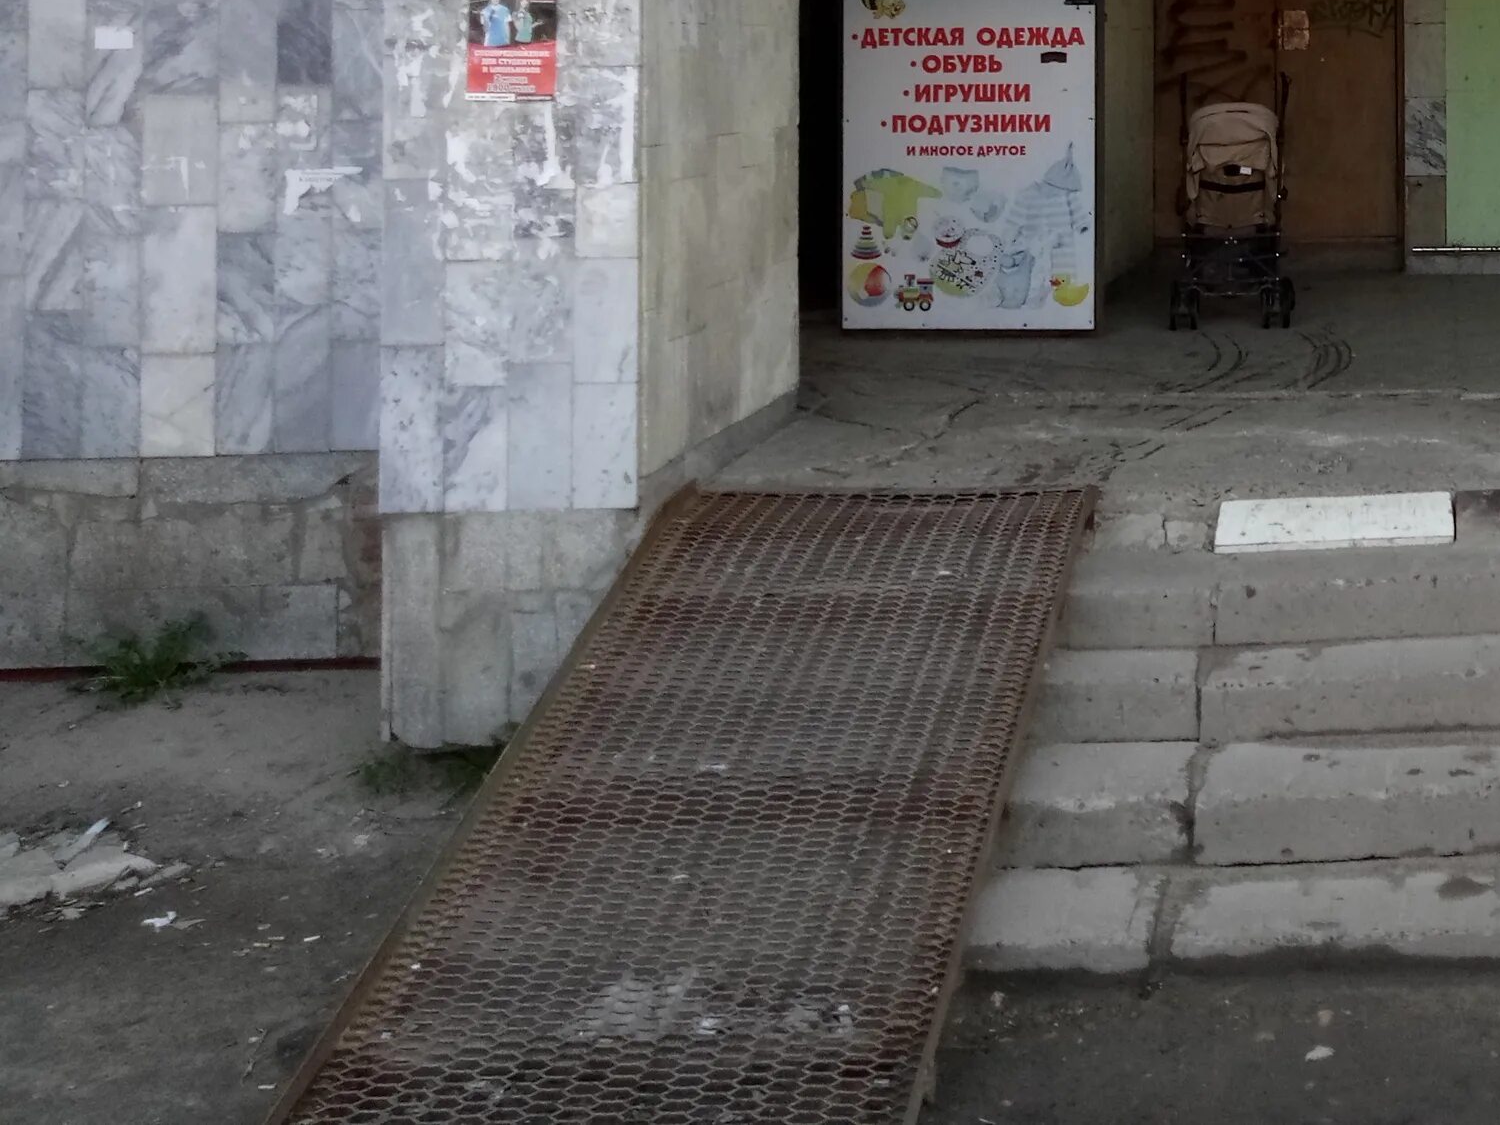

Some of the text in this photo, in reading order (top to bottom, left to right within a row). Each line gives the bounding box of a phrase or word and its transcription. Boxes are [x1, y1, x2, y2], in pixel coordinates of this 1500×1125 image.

[860, 26, 1086, 49] ДЕТСКАЯ ОДЕЖДА
[921, 54, 1004, 74] ОБУВЬ
[914, 83, 1031, 103] ИГРУШКИ
[891, 114, 1052, 136] ПОДГУЗНИКИ
[906, 145, 1026, 158] И МНОГОЕ ДРУГОЕ
